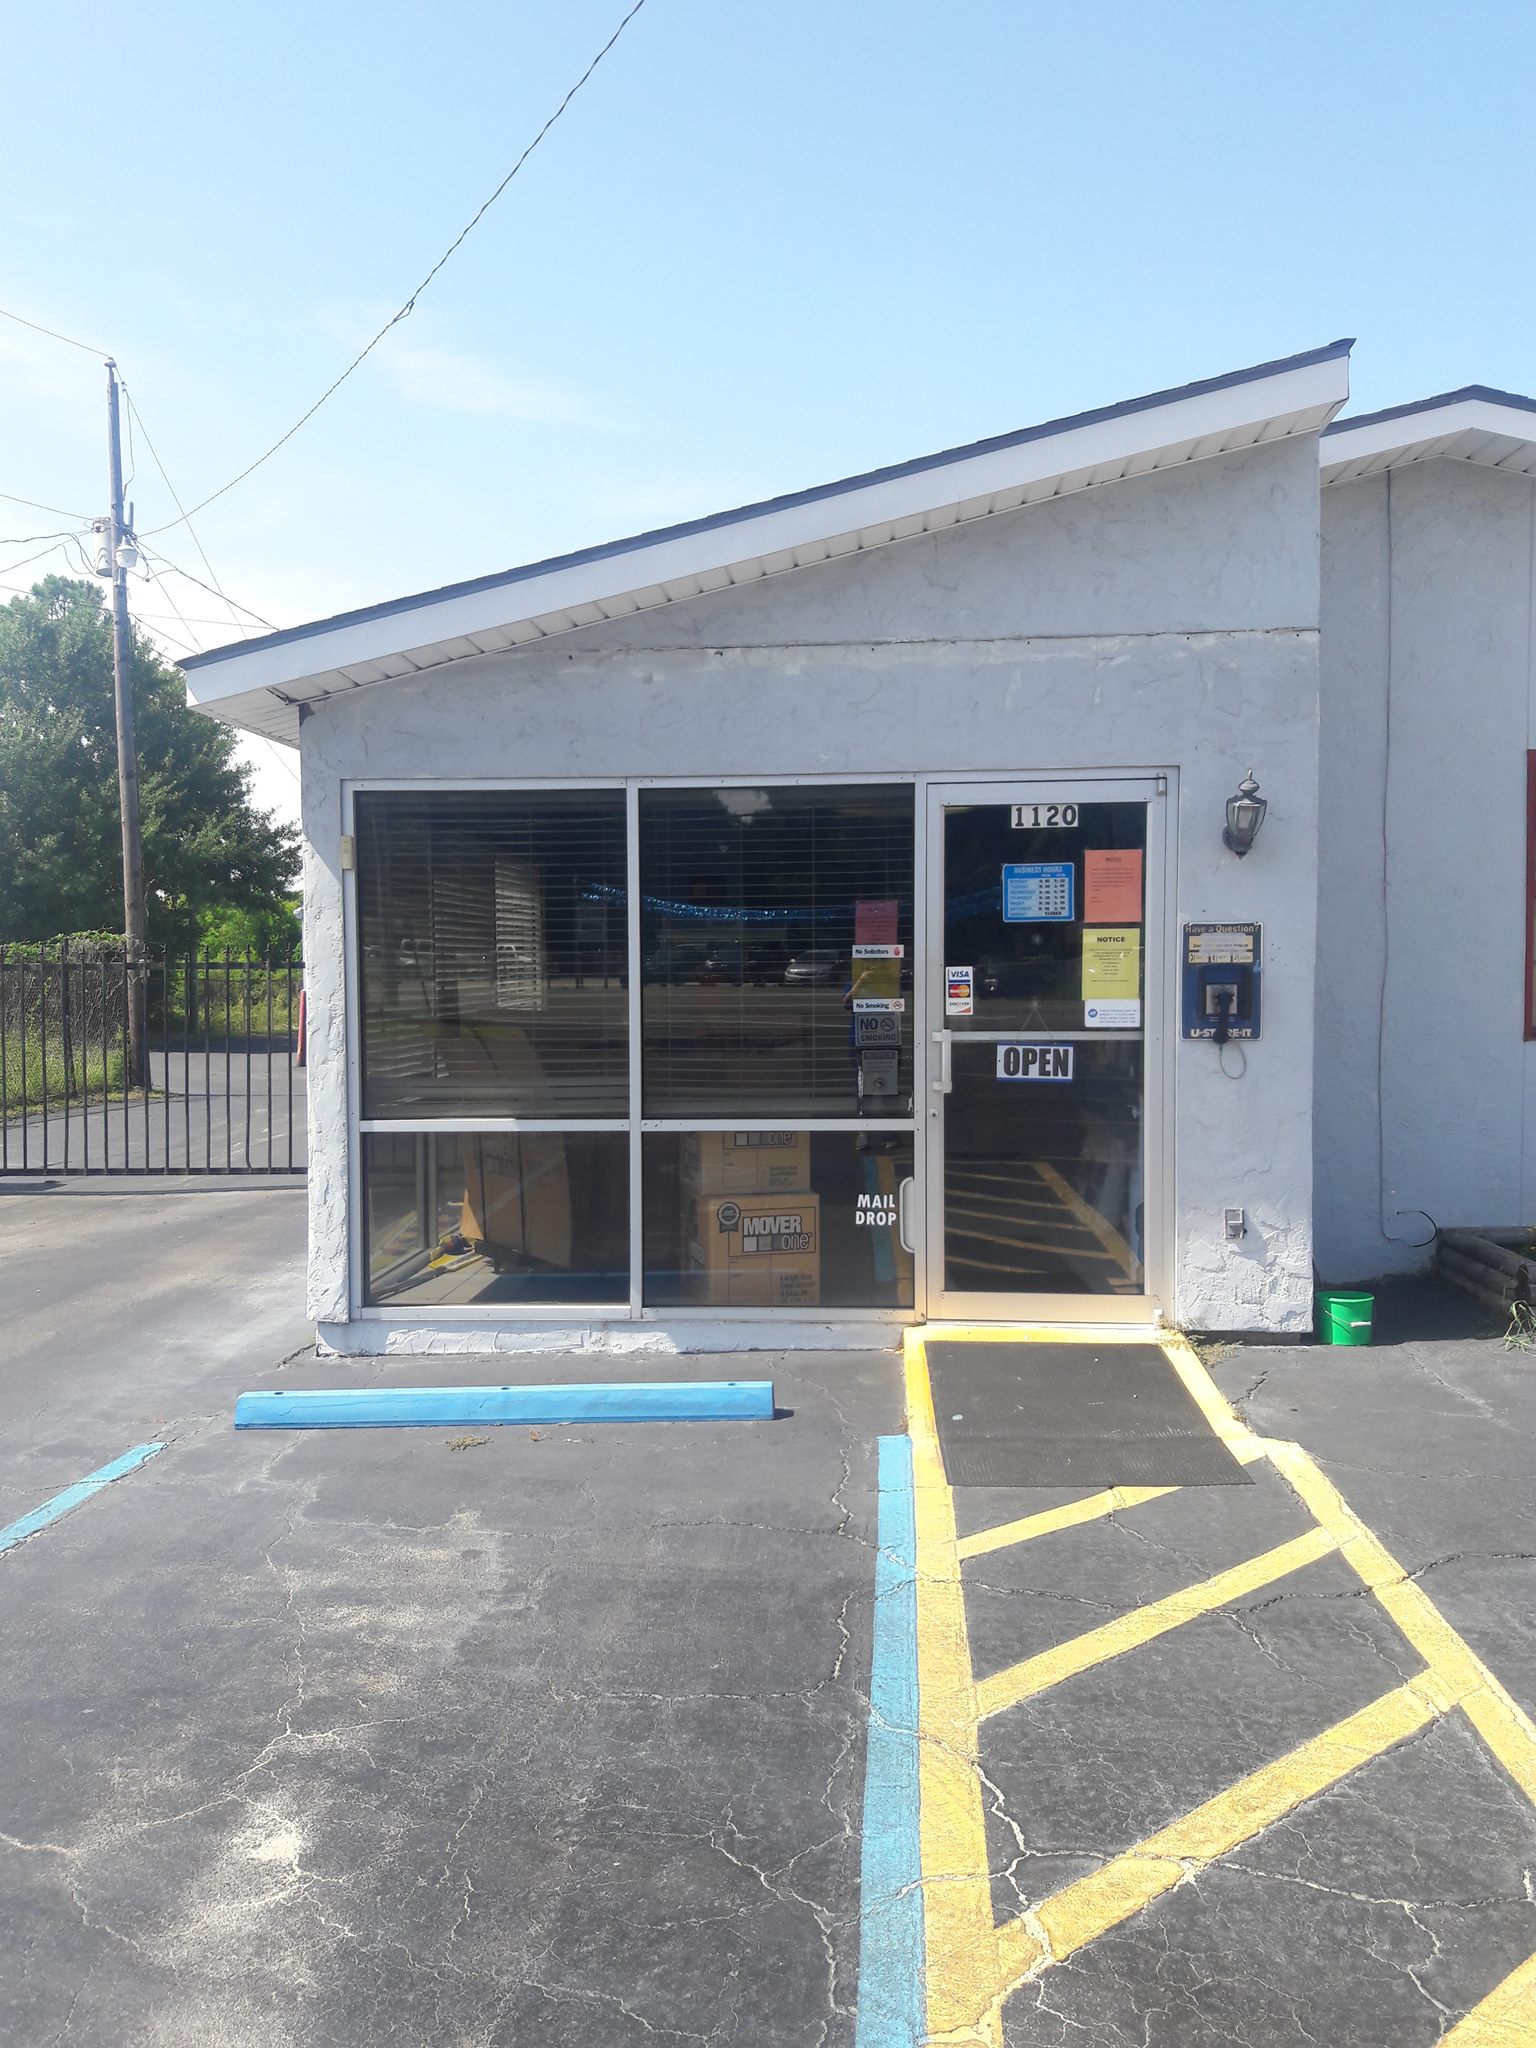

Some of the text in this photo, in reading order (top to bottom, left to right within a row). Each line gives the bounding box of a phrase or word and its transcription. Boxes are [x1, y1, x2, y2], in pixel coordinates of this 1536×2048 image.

[1015, 805, 1077, 827] 1120
[1014, 865, 1063, 874] BUSINESS HOURS
[1185, 925, 1206, 933] Have
[951, 970, 969, 978] VISA
[865, 1002, 890, 1010] Smoking
[860, 1018, 878, 1030] NO
[861, 1033, 896, 1041] SMOKING
[1004, 1047, 1069, 1077] OPEN
[857, 1193, 896, 1209] MAIL
[855, 1210, 897, 1226] DROP
[743, 1215, 802, 1235] MOVER
